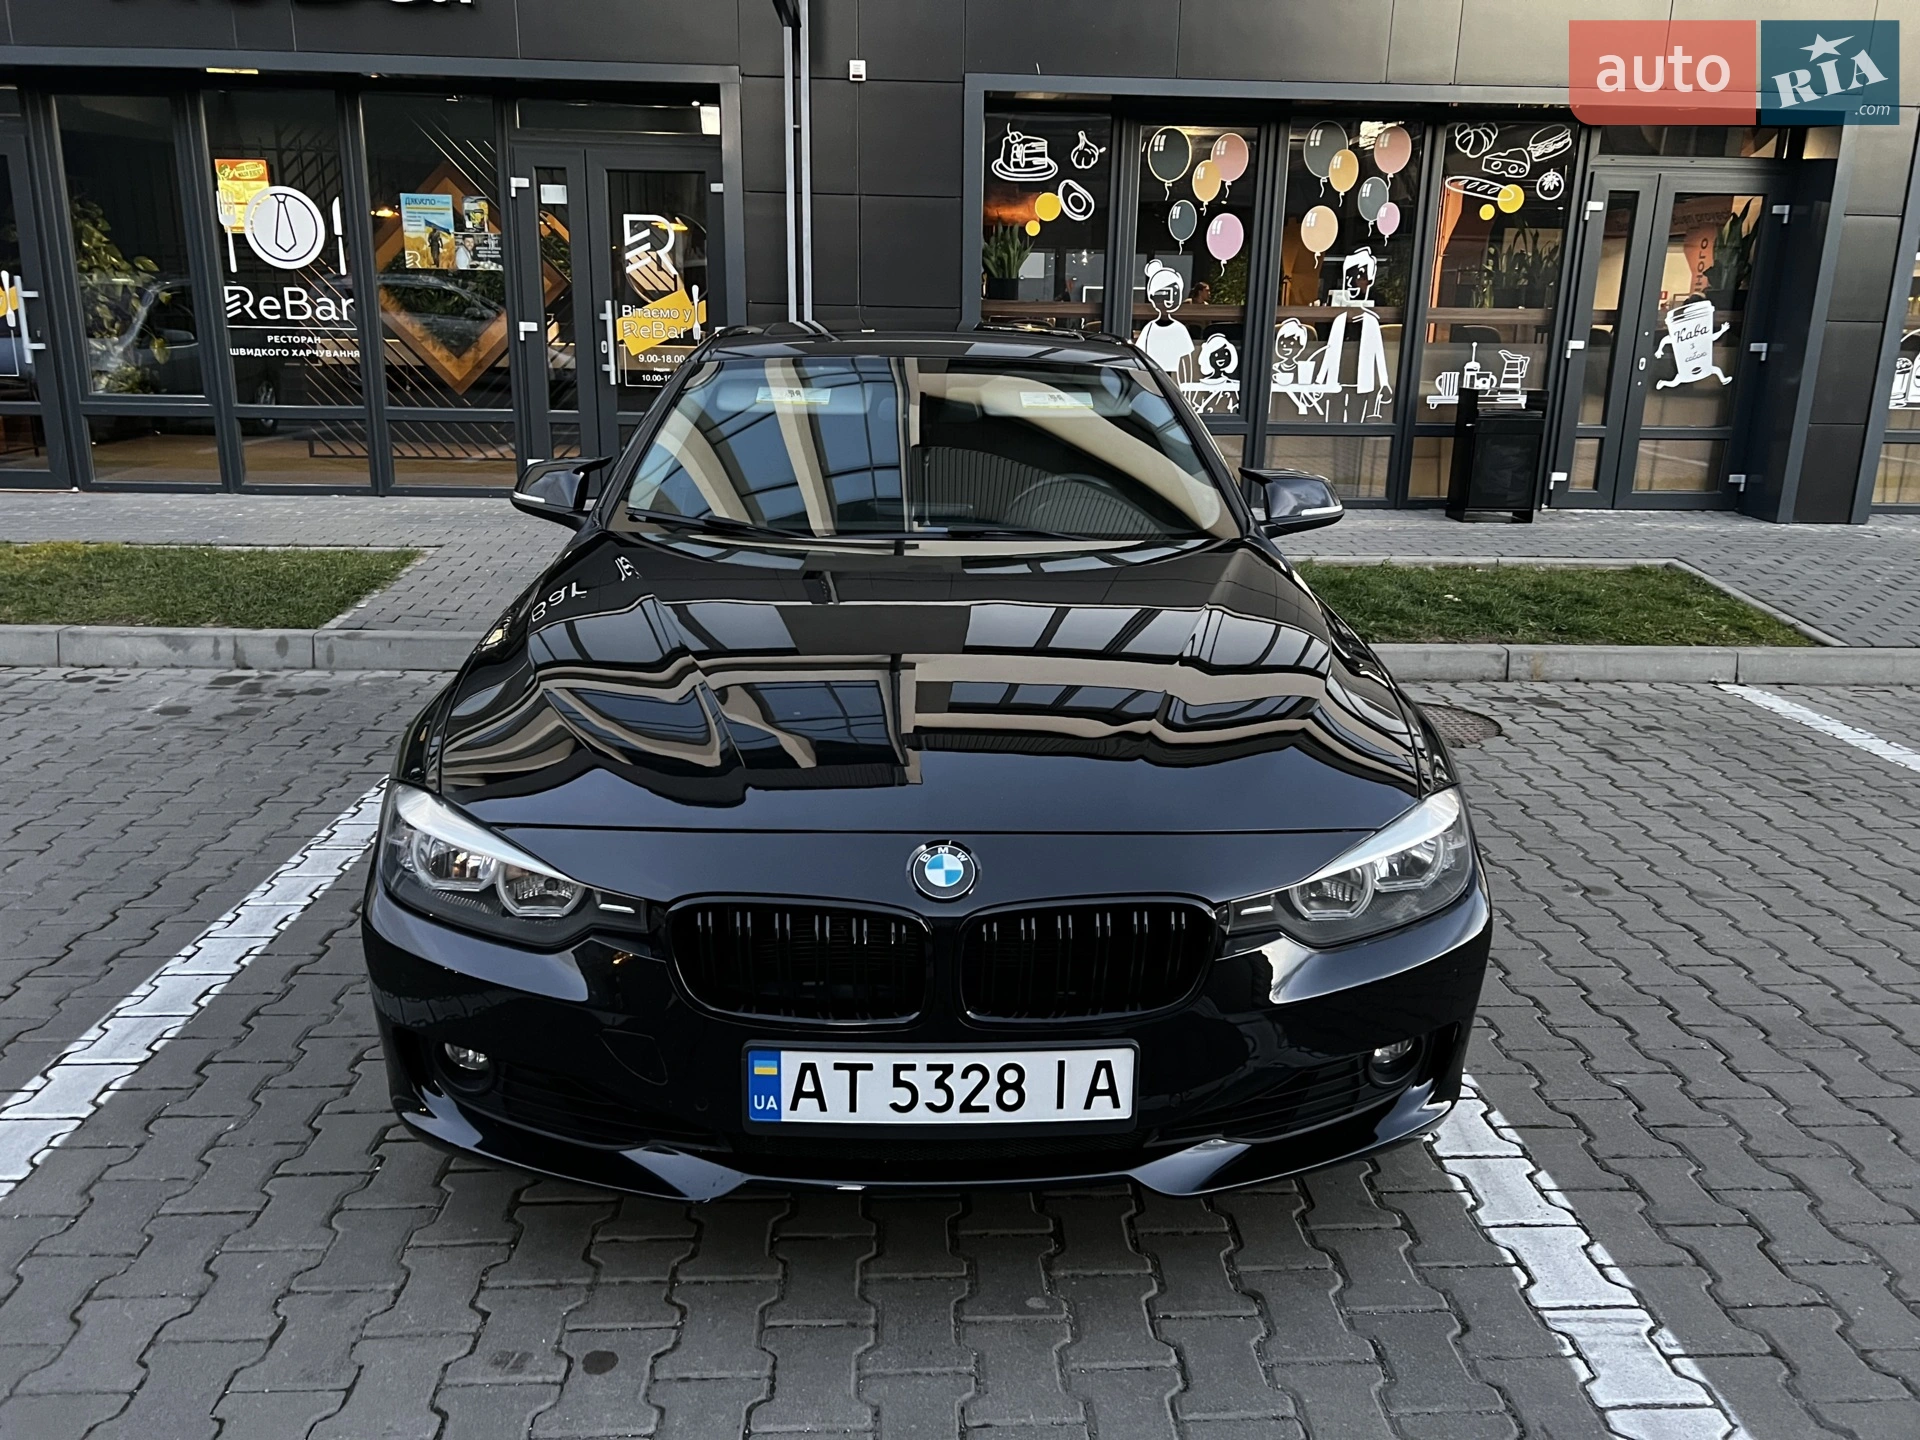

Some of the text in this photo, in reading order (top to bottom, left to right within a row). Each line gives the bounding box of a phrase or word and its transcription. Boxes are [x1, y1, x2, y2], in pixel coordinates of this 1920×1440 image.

[223, 285, 355, 321] ReBar
[622, 304, 679, 319] Вітаємо
[623, 321, 688, 339] ReBar
[1674, 323, 1710, 343] Кава
[267, 335, 321, 344] РЕСТОРАН
[229, 347, 361, 358] ШВИДКОГО ХАРЧУВАННЯ
[638, 354, 685, 363] 9.00-18.00
[919, 846, 969, 863] BMW
[789, 1062, 874, 1113] AT
[888, 1062, 1027, 1114] 5328
[754, 1094, 778, 1110] UA
